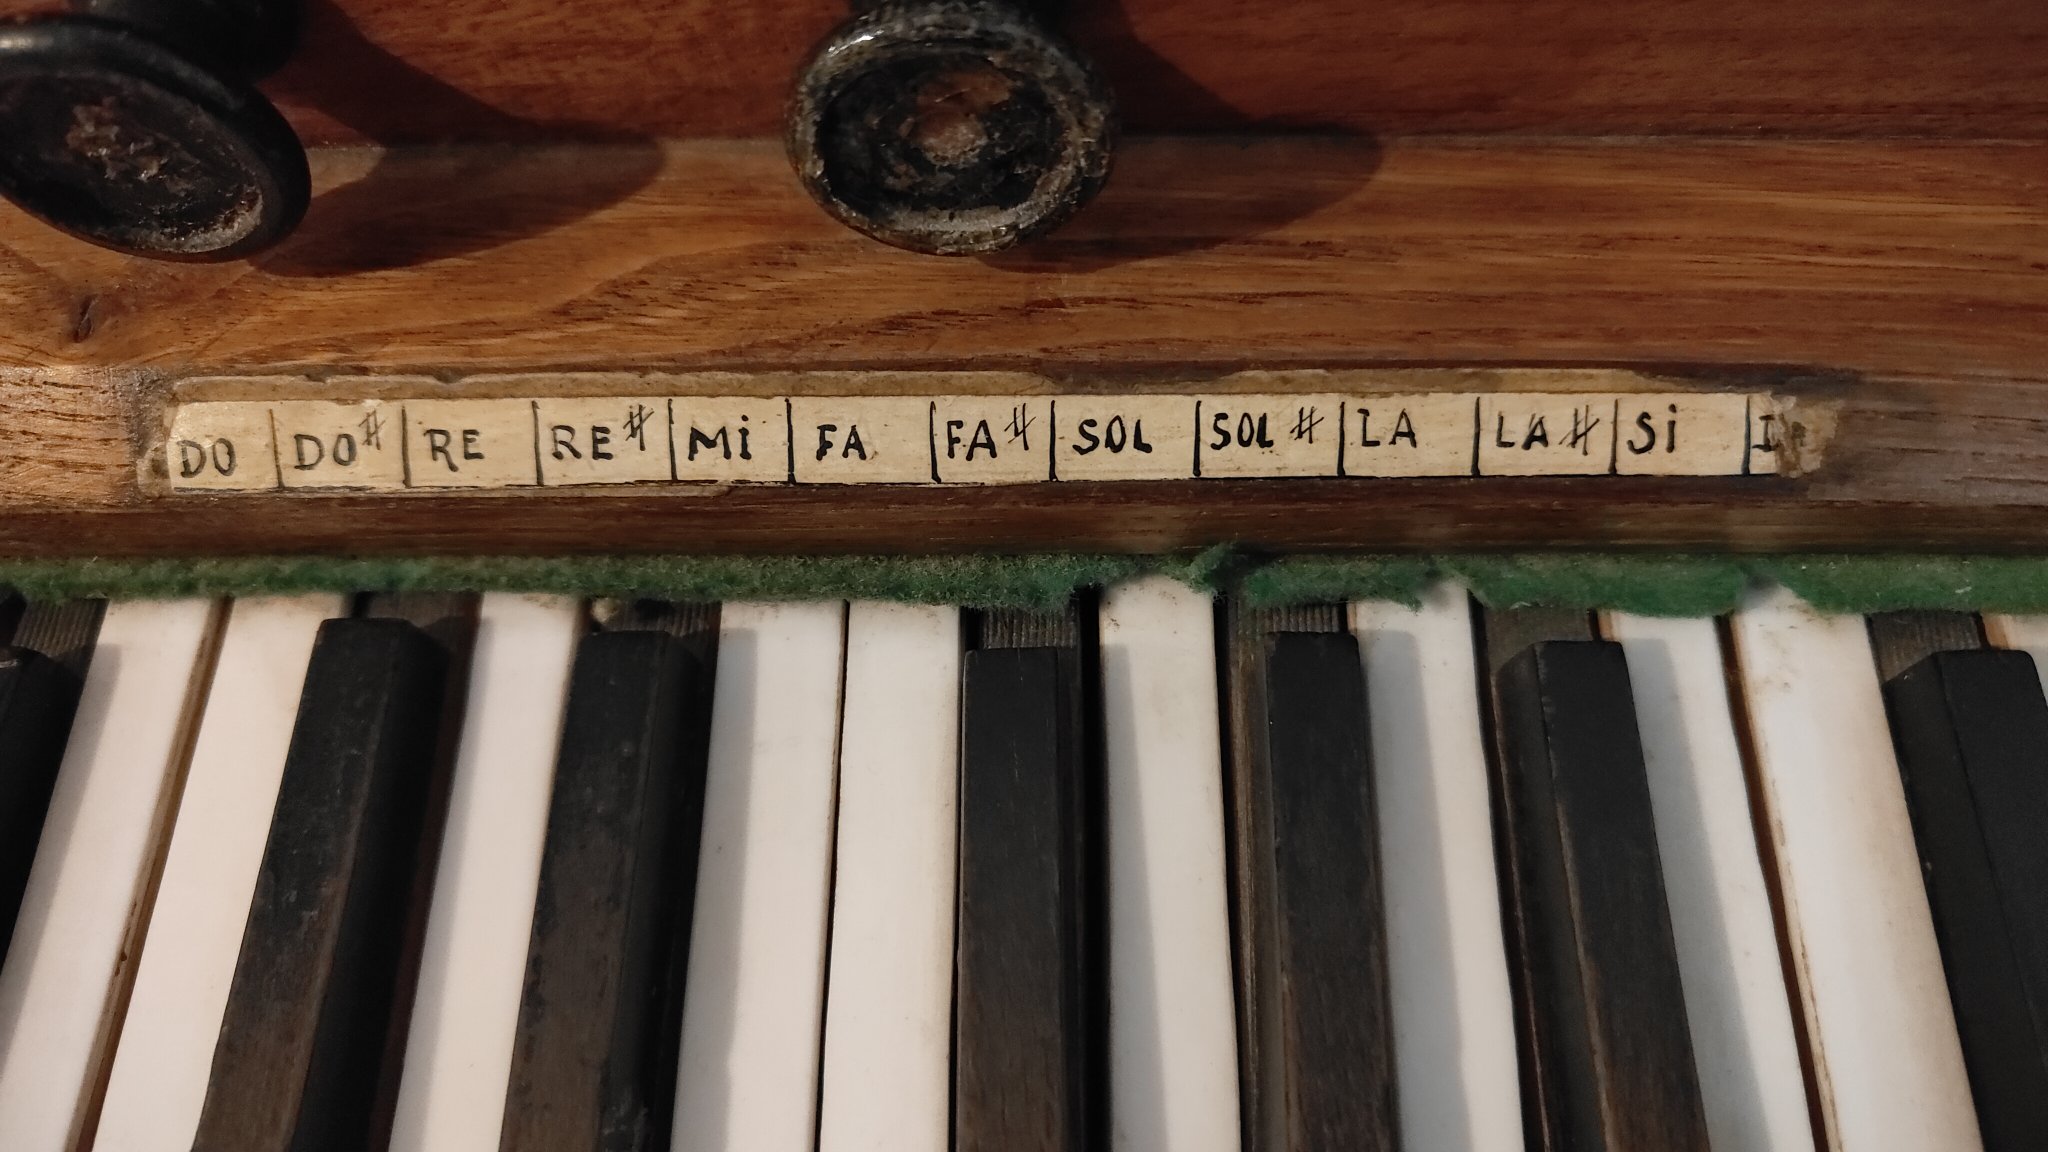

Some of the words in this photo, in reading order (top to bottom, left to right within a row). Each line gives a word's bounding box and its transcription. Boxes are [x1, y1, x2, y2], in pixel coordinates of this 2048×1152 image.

[176, 437, 236, 479] DO
[423, 427, 485, 473] RE
[551, 404, 654, 461] RE#
[815, 423, 867, 461] FA
[946, 402, 1036, 462] FA#
[1072, 414, 1153, 455] SOL
[1356, 407, 1417, 449] LA
